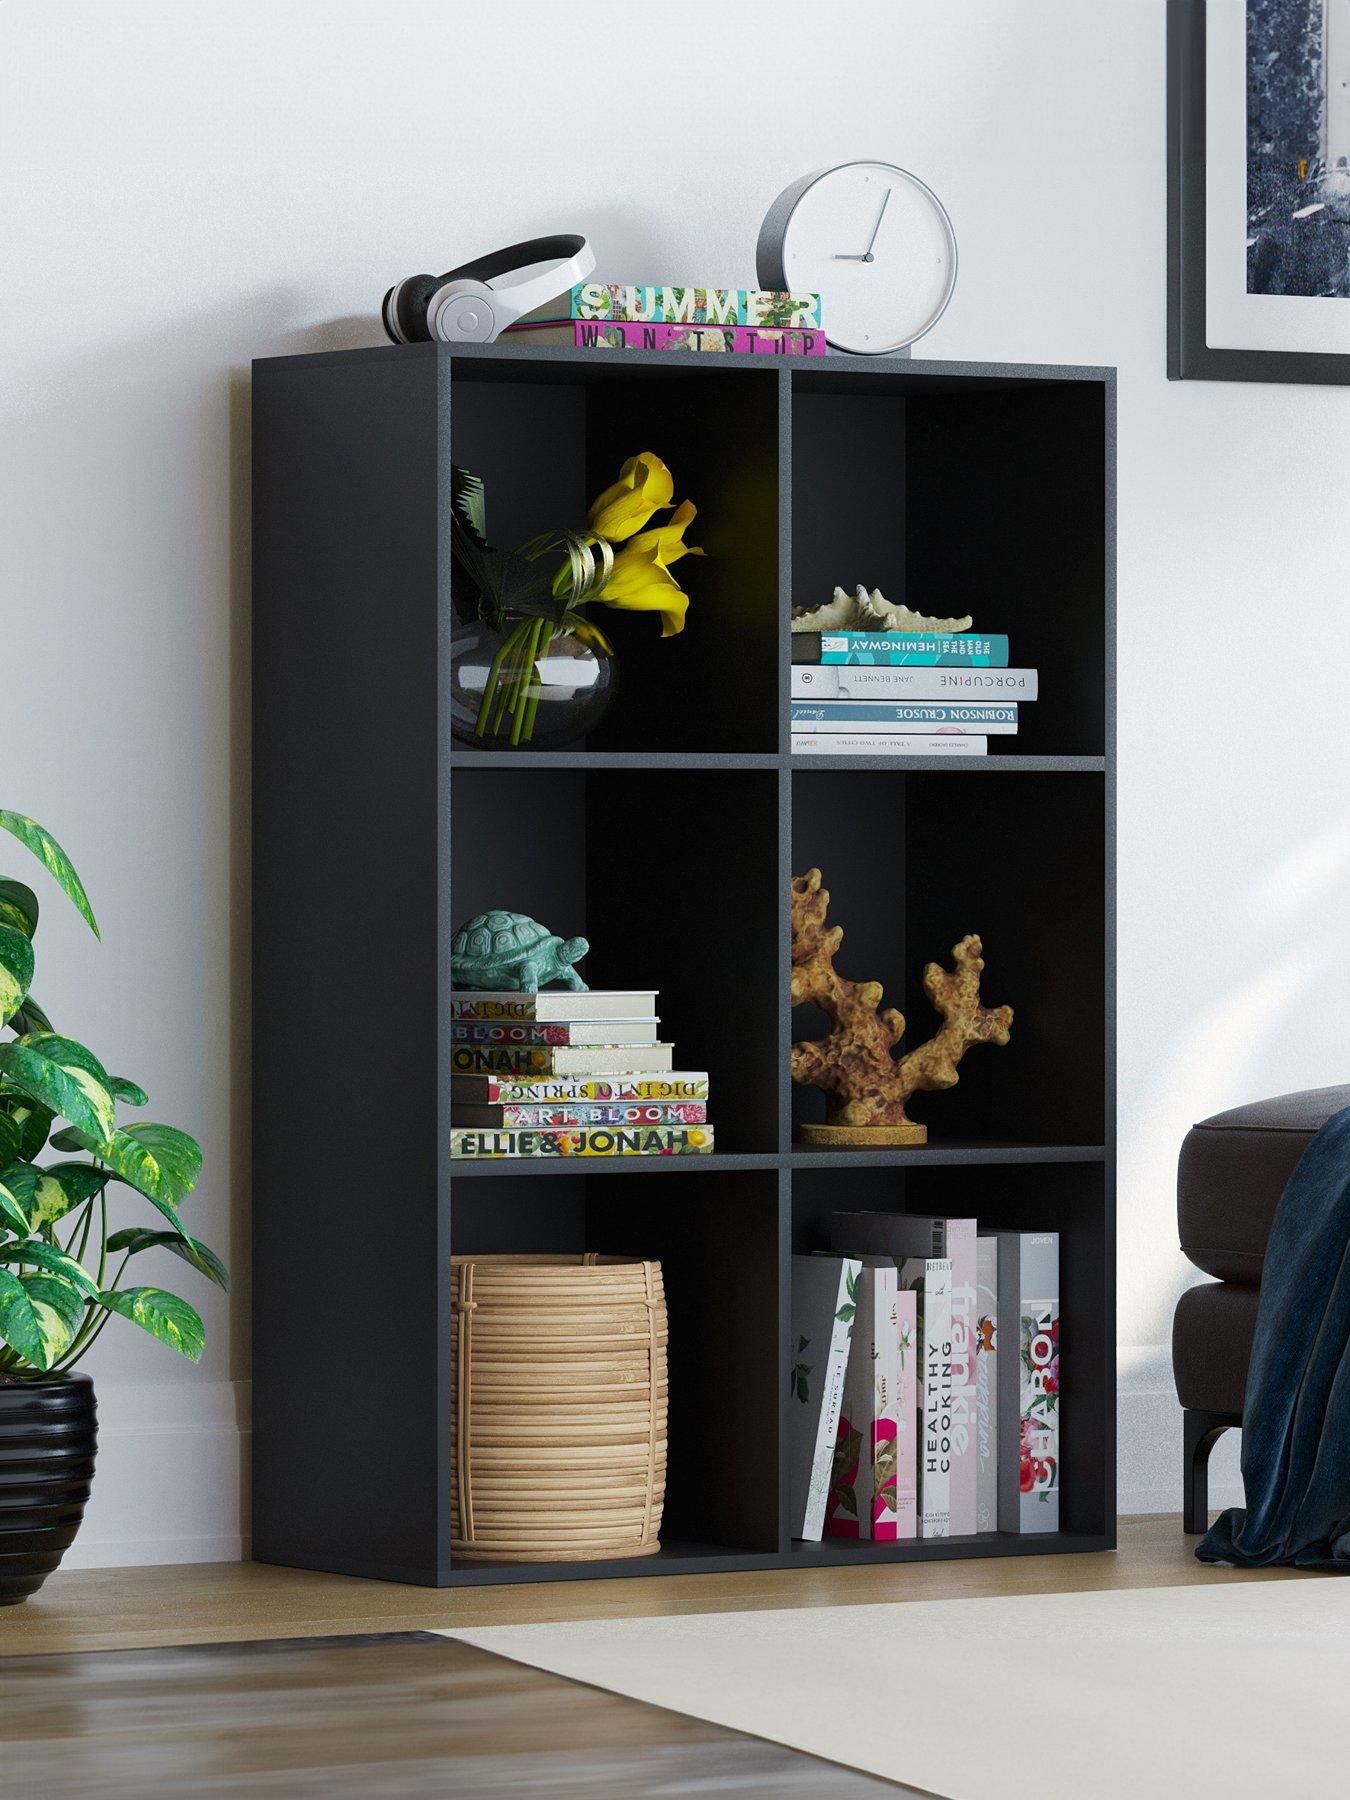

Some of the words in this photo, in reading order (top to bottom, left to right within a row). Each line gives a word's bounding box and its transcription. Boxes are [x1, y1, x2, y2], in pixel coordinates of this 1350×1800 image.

[580, 284, 819, 329] SUMMER
[851, 641, 936, 652] HEMINGWAY
[854, 675, 891, 684] BENNETT
[893, 676, 913, 684] JANE
[940, 675, 1026, 688] PORCUPINE
[896, 708, 946, 720] CRUSOE
[951, 709, 1015, 721] ROBINSON
[451, 1000, 489, 1017] INT
[494, 1003, 525, 1017] DIG
[455, 1025, 549, 1040] BLOOM
[454, 1048, 532, 1071] ONAH
[511, 1085, 588, 1099] SPRING
[597, 1082, 652, 1097] INTO
[658, 1082, 696, 1097] DIG
[515, 1108, 575, 1124] ART
[590, 1105, 686, 1123] BLOOM
[462, 1134, 535, 1155] ELLIE
[539, 1132, 564, 1153] &
[573, 1130, 691, 1154] JONAH
[1030, 1237, 1053, 1245] JOVEN
[951, 1281, 977, 1457] frankie
[827, 1385, 839, 1434] SUREAU
[926, 1343, 937, 1472] HEALTHY
[941, 1341, 953, 1473] COOKING
